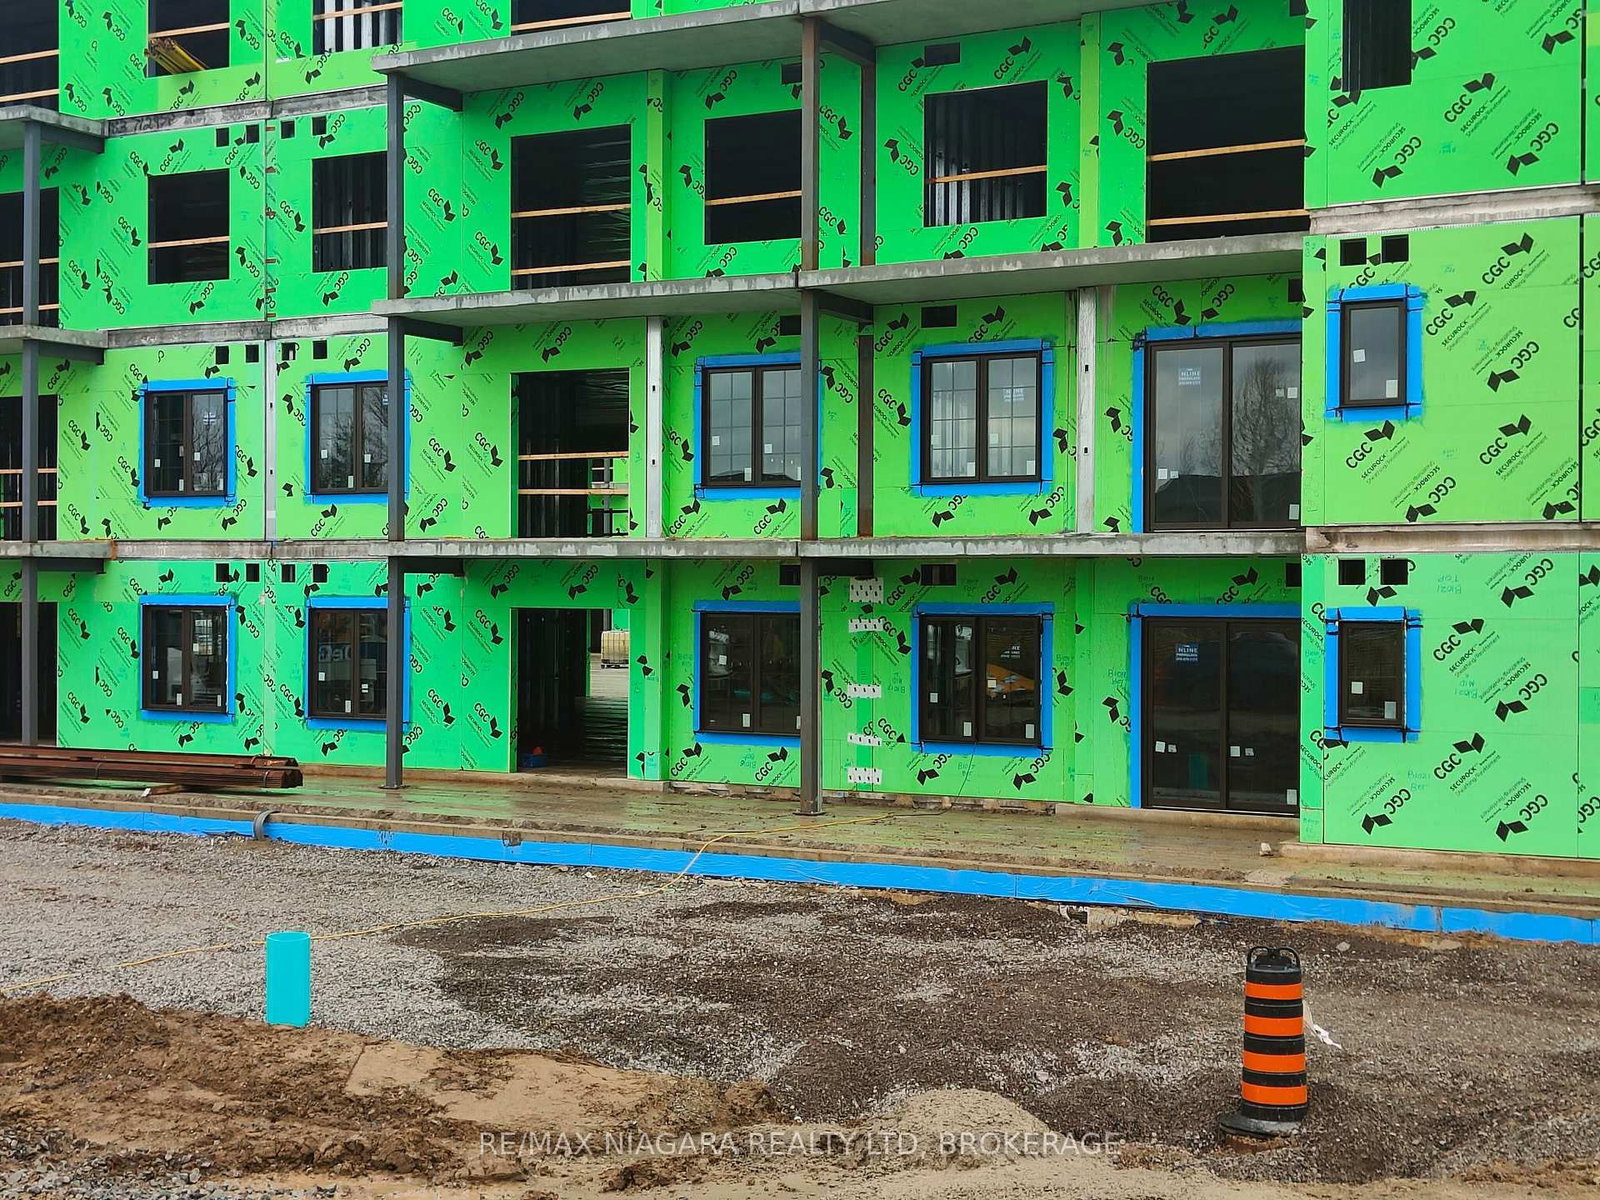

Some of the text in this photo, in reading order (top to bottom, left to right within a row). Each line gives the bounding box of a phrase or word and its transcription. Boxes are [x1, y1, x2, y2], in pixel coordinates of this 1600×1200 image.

[1204, 26, 1222, 48] GC
[1426, 18, 1455, 46] CGC
[994, 56, 1014, 79] CGC
[720, 70, 737, 91] CGC
[898, 69, 918, 92] CGC
[587, 82, 604, 102] CGC
[1444, 94, 1473, 123] CGC
[1124, 128, 1145, 148] CGC
[1530, 123, 1558, 151] CGC
[1393, 136, 1421, 164] CGC
[900, 155, 918, 175] CGC
[819, 206, 837, 227] CGC
[959, 227, 978, 249] CGC
[720, 247, 736, 267] CGC
[1482, 257, 1512, 286] CGC
[1582, 258, 1600, 278] CG
[1152, 285, 1173, 307] CGC
[1212, 284, 1234, 307] CGC
[1426, 308, 1455, 337] CGC
[1564, 308, 1579, 328] CG
[555, 327, 572, 346] CGC
[686, 320, 702, 341] CGC
[875, 331, 893, 352] CGC
[1509, 340, 1539, 369] CGC
[835, 383, 853, 403] CGC
[878, 389, 897, 409] CGC
[1346, 442, 1374, 470] CGC
[1480, 438, 1509, 466] CGC
[1427, 474, 1456, 503] CGC
[948, 495, 968, 510] GC
[311, 519, 327, 536] CGC
[475, 526, 489, 539] CG
[669, 515, 686, 535] CGC
[754, 515, 771, 534] CGC
[582, 565, 598, 584] CGC
[737, 565, 754, 585] CGC
[1525, 559, 1553, 585] CGC
[887, 585, 907, 608] CGC
[1312, 602, 1325, 622] CG
[1434, 635, 1461, 660] CGC
[1519, 674, 1547, 700] CGC
[834, 688, 852, 708] CGC
[878, 718, 896, 739] CGC
[1310, 730, 1324, 750] CG
[671, 758, 687, 776] CGC
[755, 762, 772, 781] CGC
[933, 754, 952, 769] GC
[1434, 754, 1461, 779] CGC
[1384, 789, 1410, 814] CGC
[1520, 795, 1548, 821] CGC
